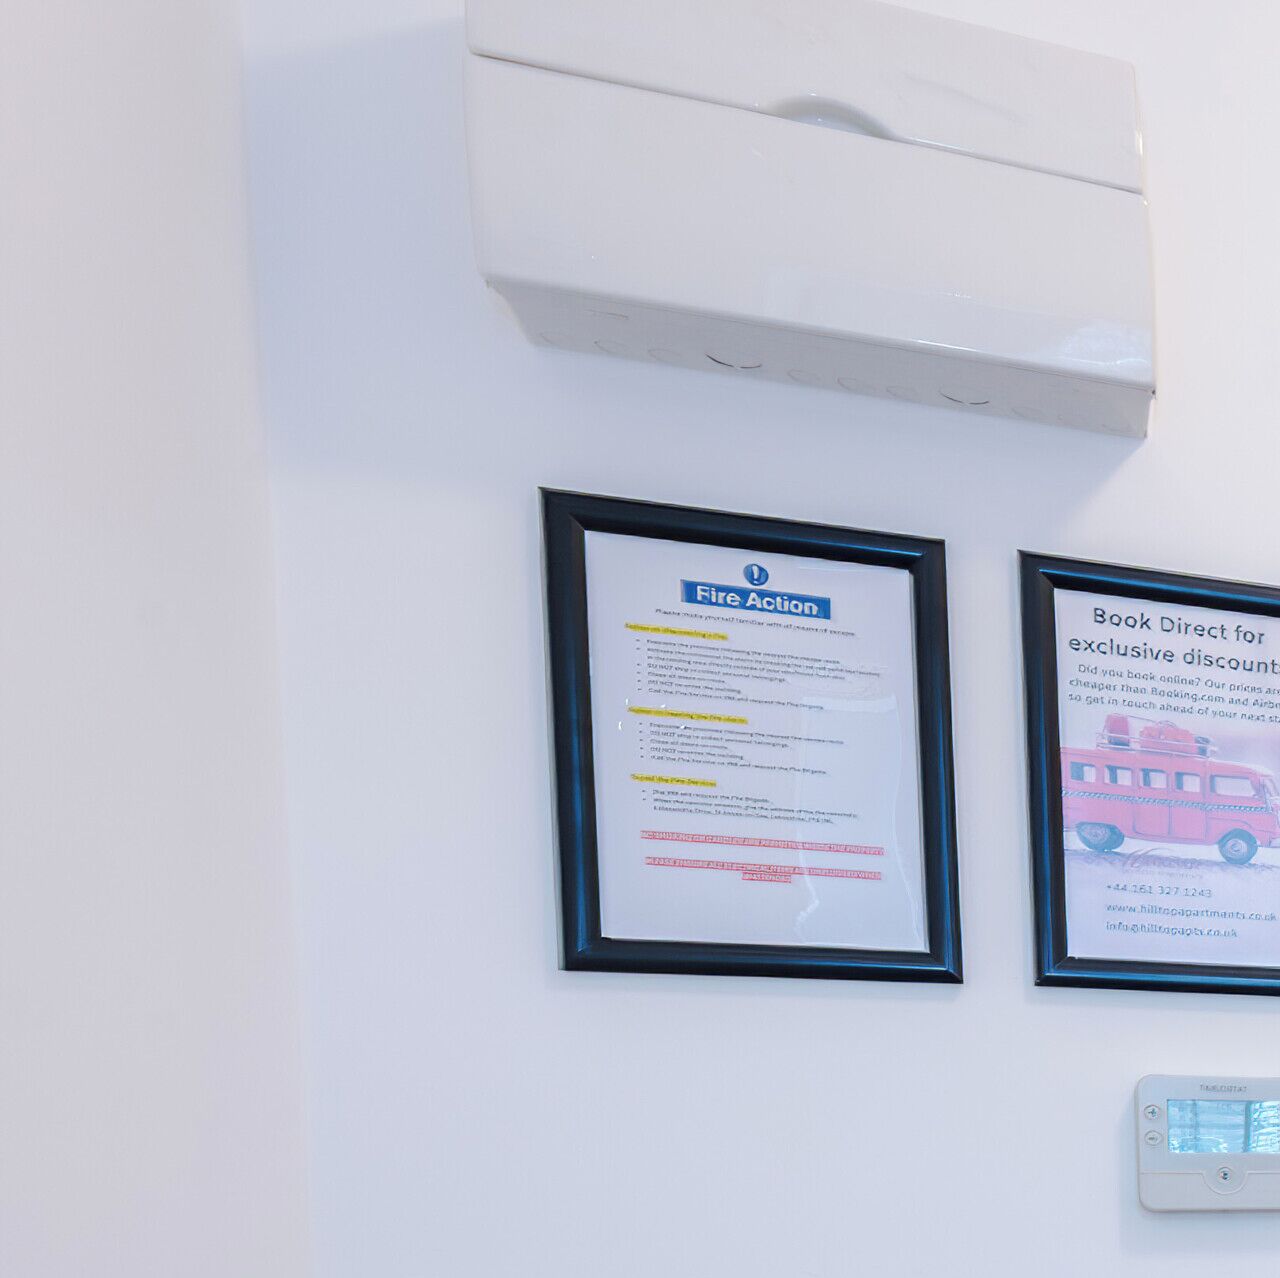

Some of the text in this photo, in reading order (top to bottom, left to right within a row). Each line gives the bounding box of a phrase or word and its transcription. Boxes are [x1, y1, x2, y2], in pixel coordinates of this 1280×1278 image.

[696, 585, 819, 615] Fire Action
[1093, 607, 1265, 645] Book Direct for
[1068, 637, 1175, 663] exclusive
[1069, 678, 1117, 692] cheaper
[1120, 683, 1147, 695] than
[1151, 686, 1224, 704] Booking.com
[1228, 697, 1249, 707] and
[1078, 664, 1098, 675] Did
[1101, 668, 1123, 678] you
[1127, 669, 1155, 681] book
[1159, 673, 1201, 687] online?
[1204, 679, 1226, 690] Our
[1229, 683, 1262, 694] prices
[1085, 695, 1104, 706] get
[1107, 696, 1118, 706] in
[1122, 699, 1156, 710] touch
[1159, 703, 1194, 715] ahead
[1197, 706, 1209, 716] of
[1211, 708, 1237, 719] your
[1241, 712, 1266, 723] next
